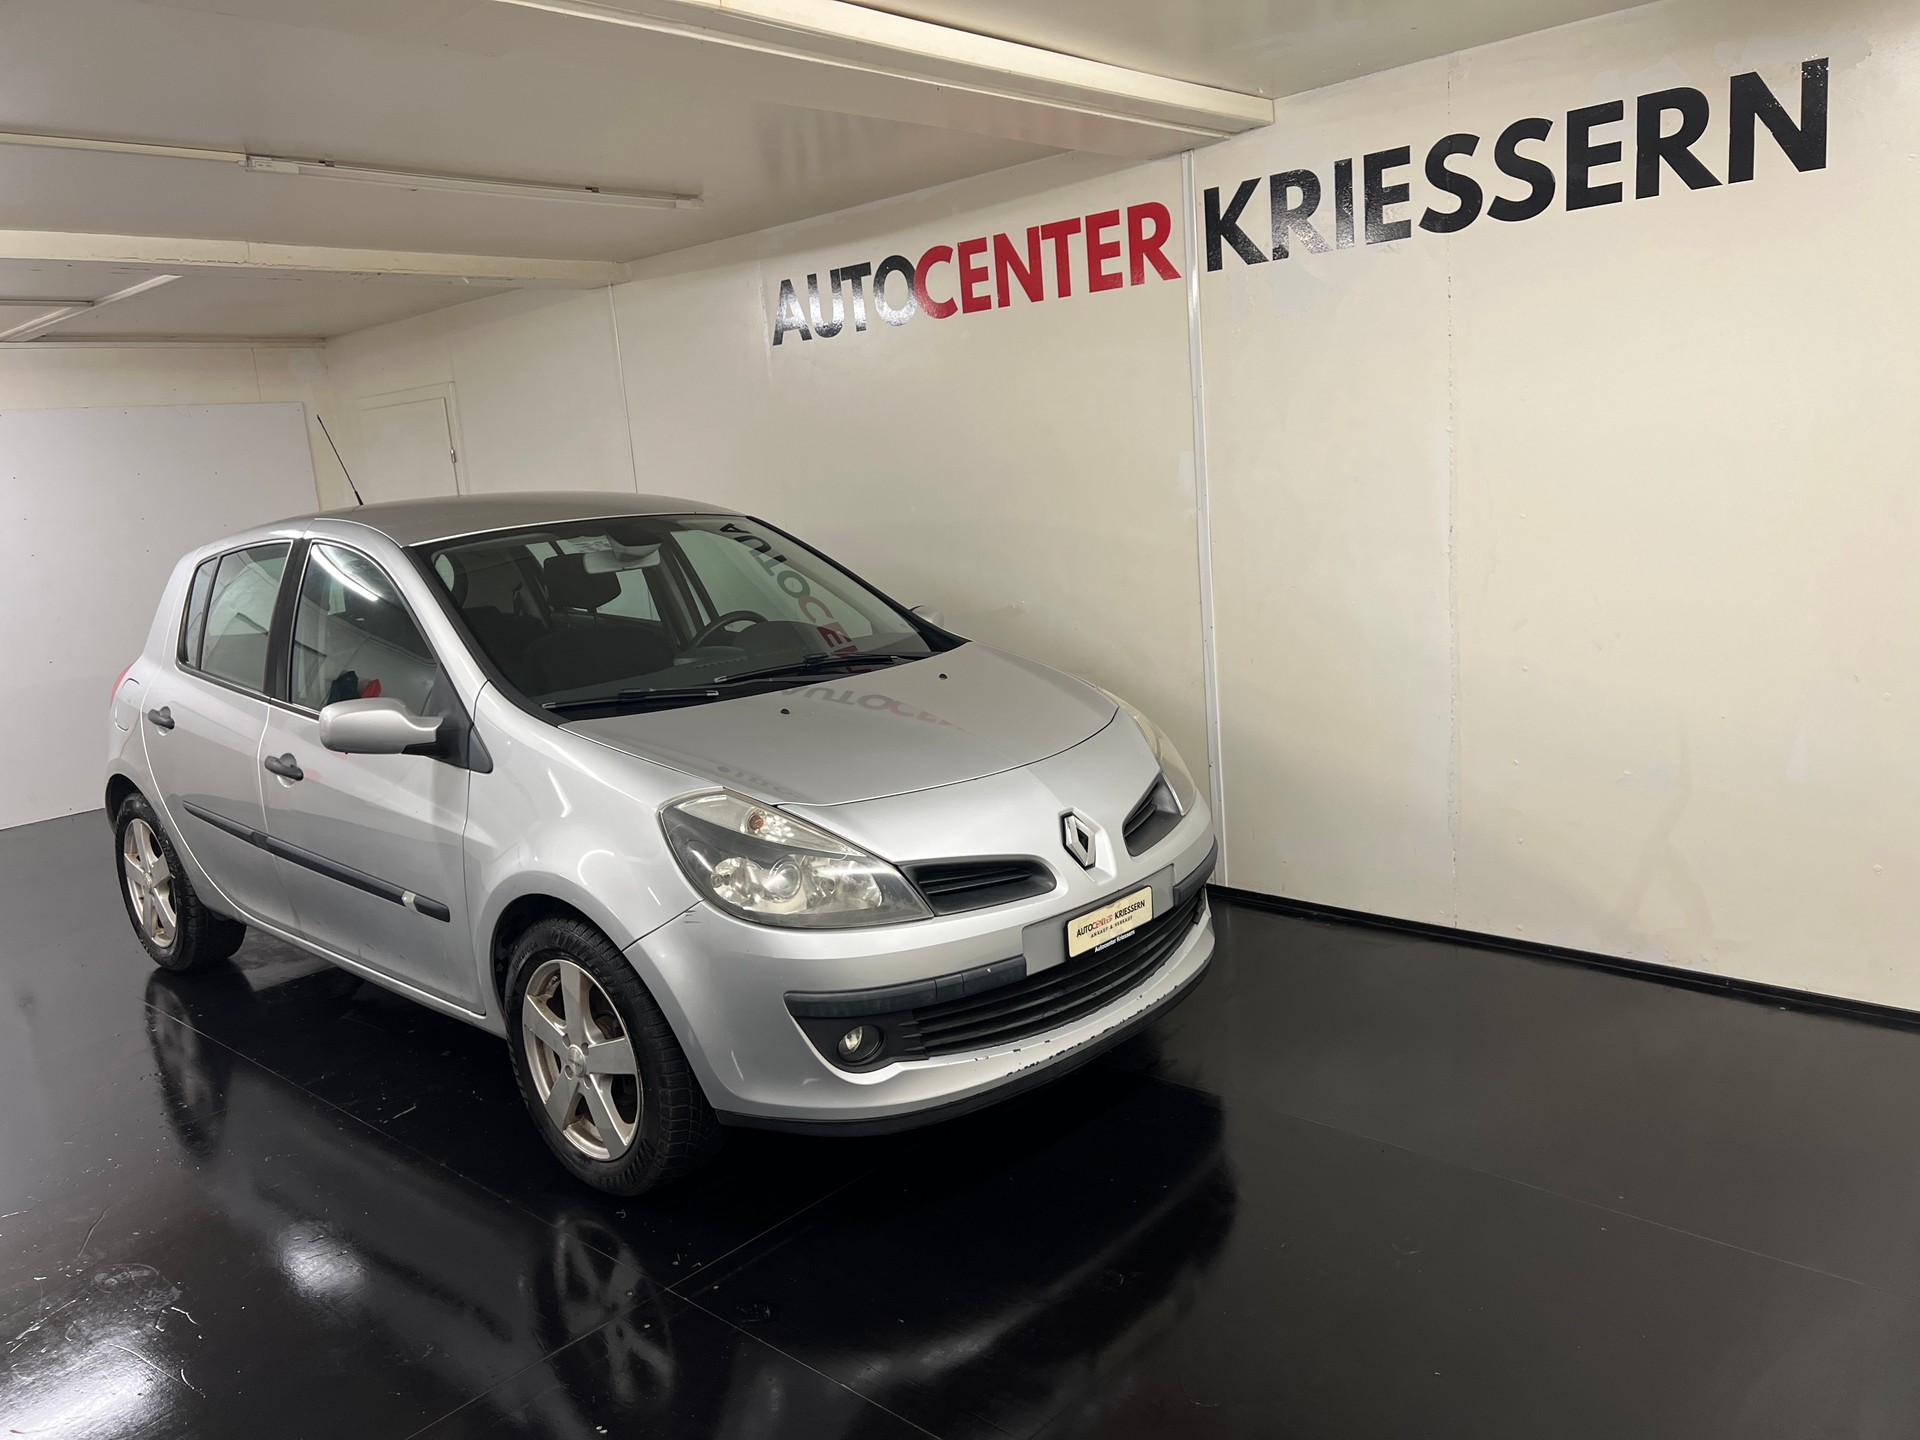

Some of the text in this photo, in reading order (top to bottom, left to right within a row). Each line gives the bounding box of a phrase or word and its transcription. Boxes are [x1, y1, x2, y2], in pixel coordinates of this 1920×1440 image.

[772, 57, 1829, 346] AUTOCENTER KRIESSERN
[1114, 899, 1145, 920] KRIESSERN
[1114, 915, 1133, 929] VERKAUF
[1094, 930, 1136, 953] Autocenter Kriessern
